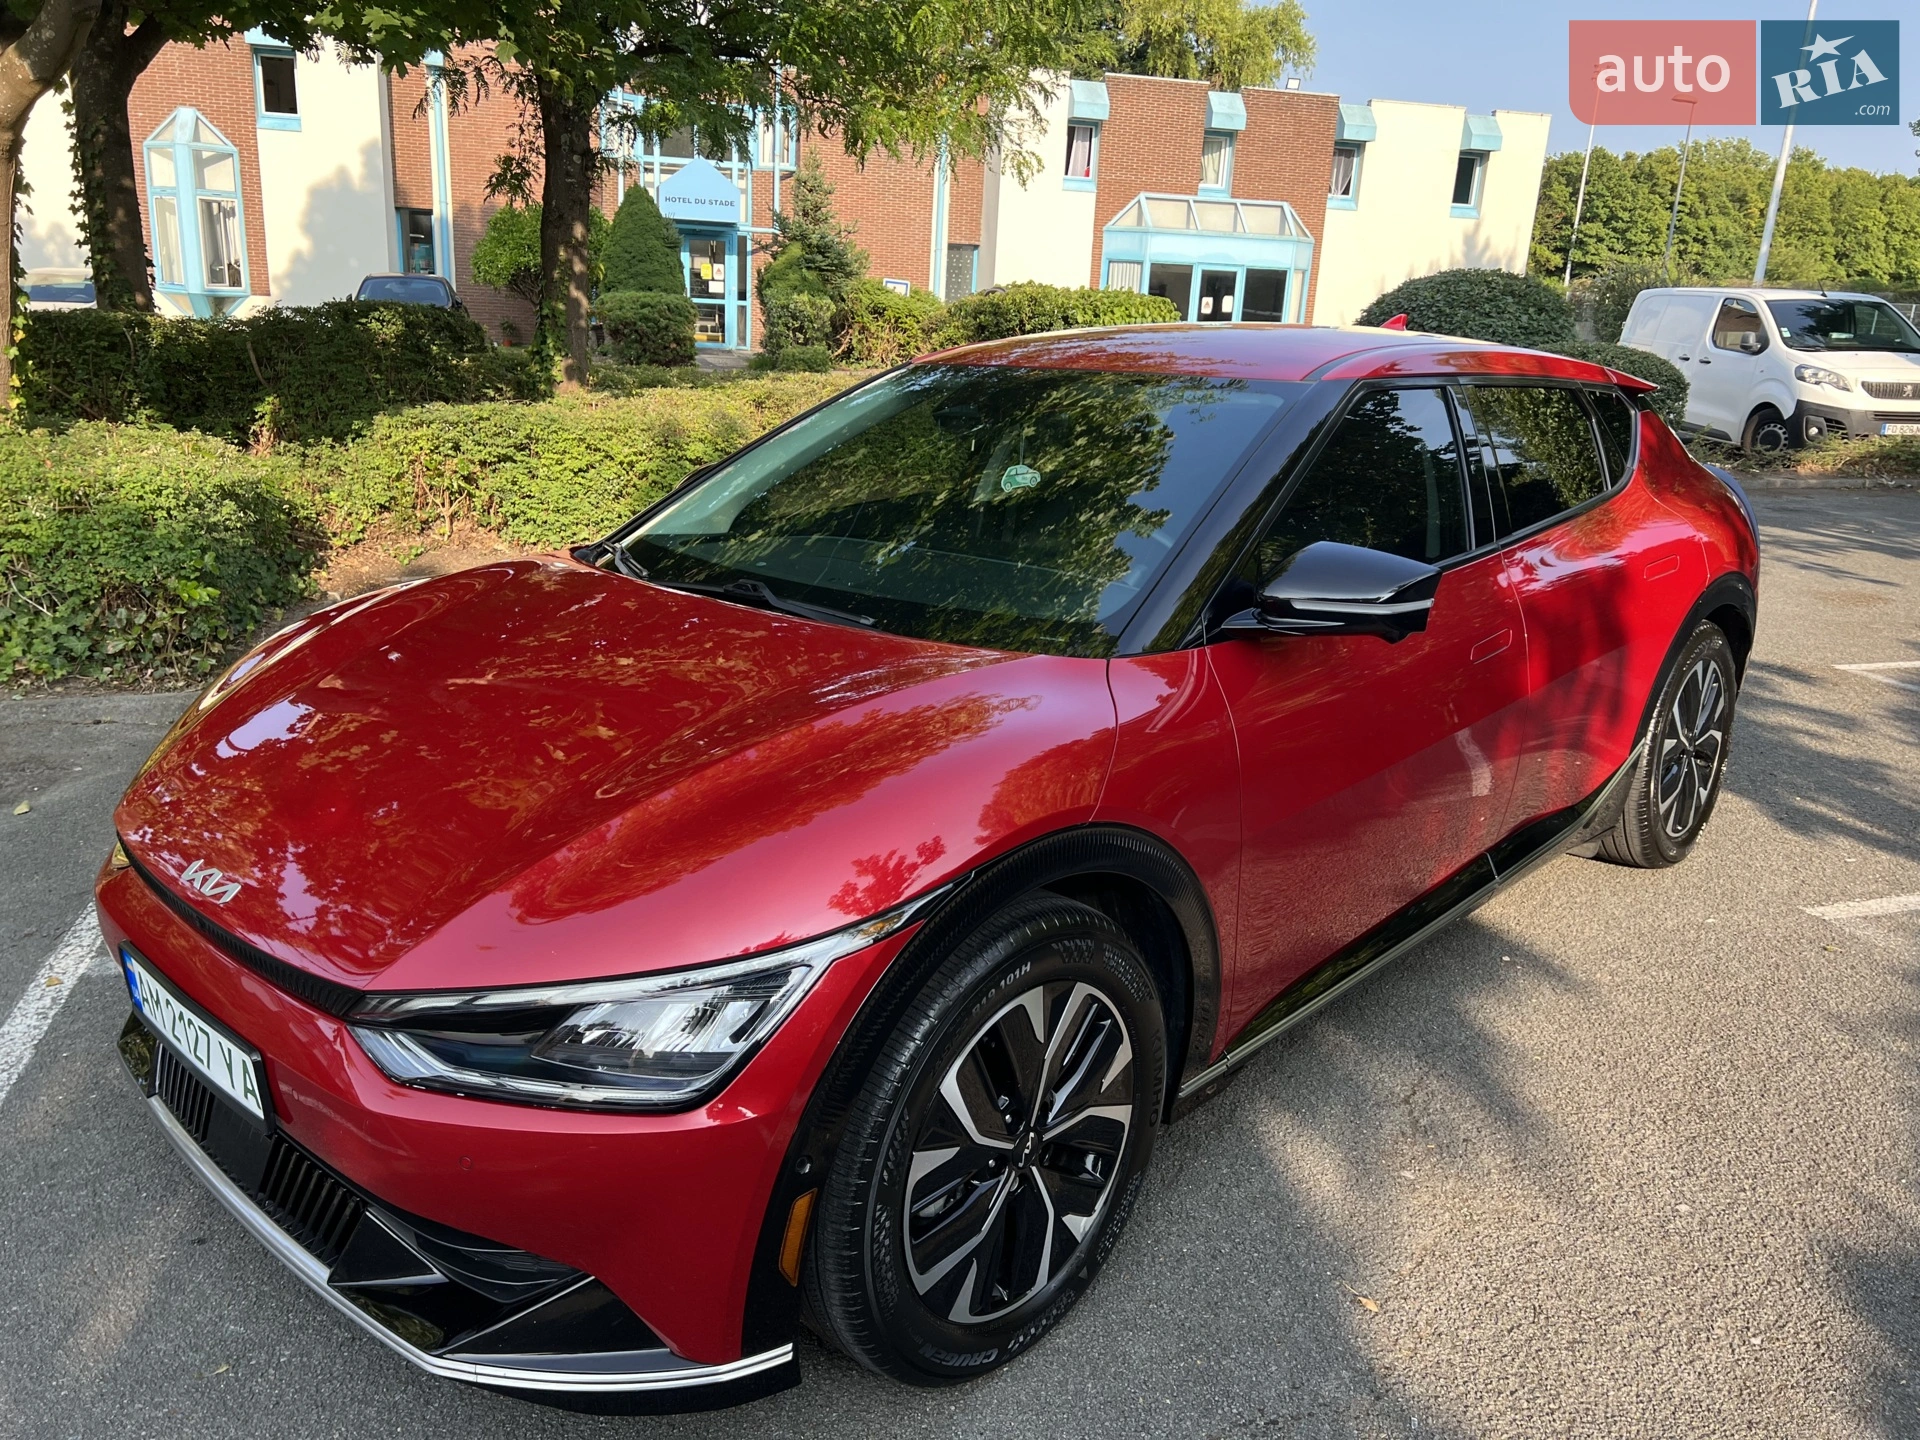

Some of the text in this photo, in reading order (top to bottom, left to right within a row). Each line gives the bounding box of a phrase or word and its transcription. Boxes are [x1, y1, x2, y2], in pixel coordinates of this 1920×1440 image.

[664, 196, 692, 204] HOTEL
[708, 199, 735, 207] STADE
[181, 859, 241, 904] KIA
[999, 961, 1031, 990] 101H
[138, 970, 262, 1111] AM 2127 YA
[1149, 1028, 1163, 1128] KUMHO
[918, 1343, 999, 1368] CRUGEN
